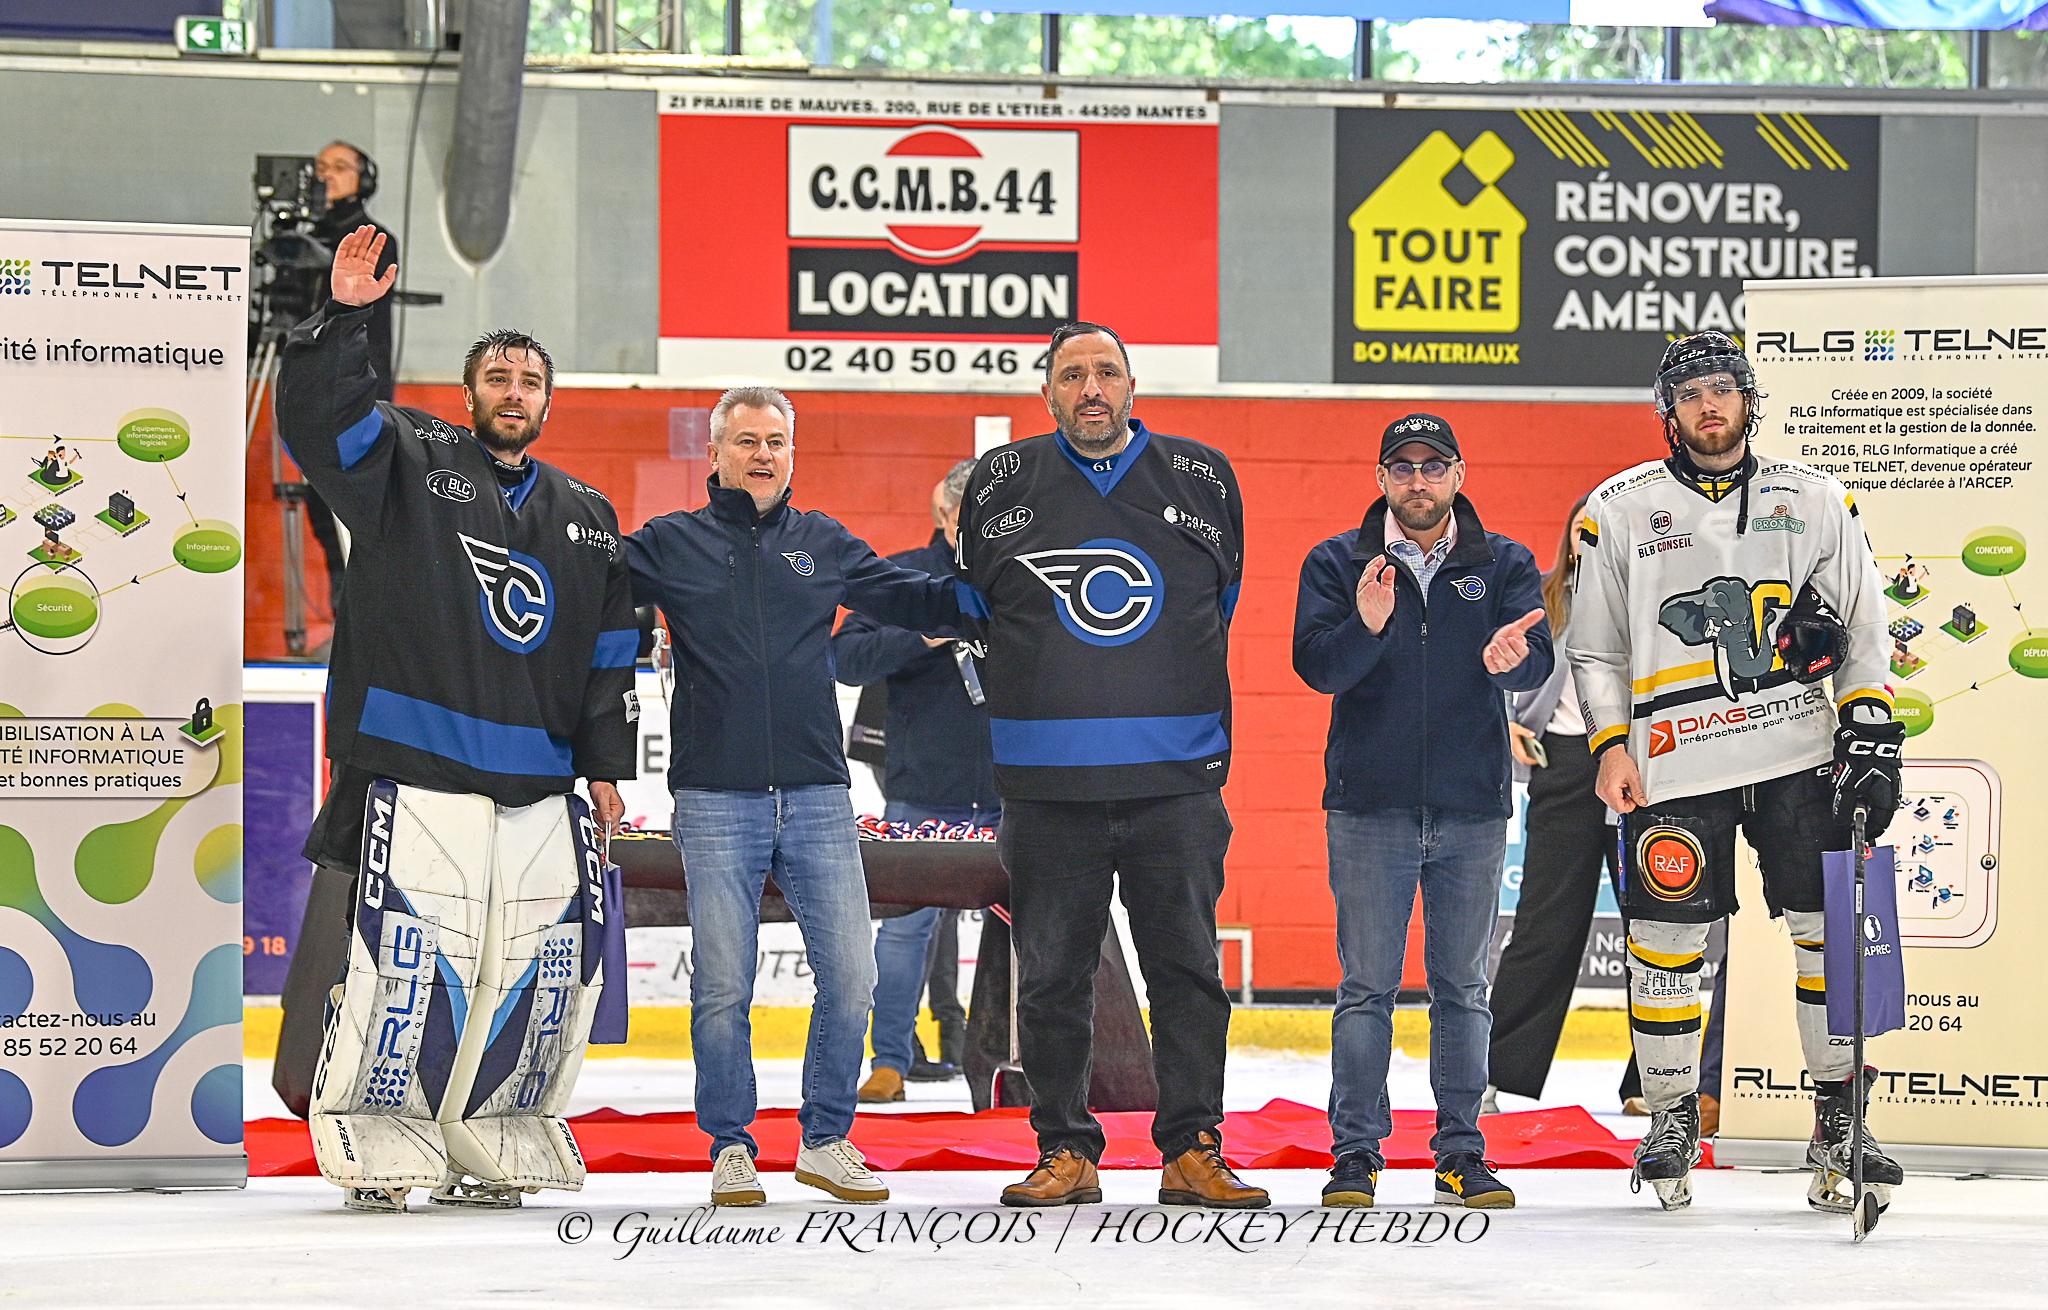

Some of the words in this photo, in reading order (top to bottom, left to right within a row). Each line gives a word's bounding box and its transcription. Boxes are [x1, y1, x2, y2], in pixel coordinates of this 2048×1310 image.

[693, 96, 763, 110] PRAIRIE
[770, 98, 793, 111] DE
[927, 102, 961, 115] RUE
[968, 103, 992, 116] DE
[997, 103, 1063, 117] L'ETIER
[1079, 104, 1130, 118] 44300
[1136, 105, 1207, 119] NANTES
[810, 164, 1057, 215] C.C.M.B.44
[1555, 175, 1800, 231] RÉNOVER,
[1373, 228, 1502, 265] TOUT
[1553, 235, 1874, 280] CONSTRUIRE,
[41, 260, 242, 291] TELNET
[41, 289, 140, 299] TÉLÉPHONIE
[169, 294, 242, 302] INTERNET
[797, 270, 1070, 319] LOCATION
[1374, 275, 1502, 313] FAIRE
[1756, 330, 1855, 354] RLG
[1904, 328, 2047, 351] TELNE
[46, 338, 224, 371] informatique
[786, 346, 832, 373] 02
[847, 347, 894, 373] 40
[910, 347, 956, 374] 50
[971, 349, 1018, 375] 46
[1354, 342, 1386, 363] BO
[1393, 342, 1520, 366] MATERIAUX
[1680, 349, 1706, 362] CCM
[1756, 355, 1855, 363] INFORMATIQUE
[1903, 353, 1987, 361] TÉLÉPHONIE
[1831, 388, 1869, 401] Créée
[1872, 390, 1888, 401] en
[1891, 388, 1928, 402] 2009,
[1932, 387, 1943, 400] la
[1946, 387, 1993, 400] société
[1789, 406, 1817, 418] RLG
[1820, 405, 1903, 421] Informatique
[1906, 407, 1926, 417] est
[1928, 404, 1999, 419] spécialisée
[2002, 404, 2033, 416] dans
[1784, 423, 1796, 435] le
[1799, 423, 1866, 435] traitement
[1869, 423, 1883, 434] et
[1885, 422, 1897, 434] la
[1900, 421, 1948, 437] gestion
[1951, 421, 1967, 433] de
[1970, 421, 1982, 433] la
[1985, 420, 2037, 433] donnée.
[1801, 445, 1818, 456] En
[1822, 444, 1860, 458] 2016,
[1863, 444, 1890, 456] RLG
[1893, 442, 1976, 459] Informatique
[1979, 446, 1988, 455] a
[1990, 441, 2018, 454] créé
[1093, 460, 1113, 472] 61
[1697, 467, 1744, 483] CCM
[1761, 463, 1789, 475] BTP
[1807, 463, 1850, 475] arque
[1853, 460, 1908, 474] TELNET,
[1911, 460, 1966, 472] devenue
[1969, 459, 2033, 475] opérateur
[448, 478, 471, 495] BLC
[1600, 481, 1626, 500] BTP
[1628, 466, 1667, 485] SAVOIE
[1840, 477, 1887, 492] onique
[1890, 477, 1945, 490] déclarée
[1948, 477, 1956, 489] à
[1959, 476, 2014, 489] l'ARCEP.
[1000, 510, 1026, 528] BLC
[185, 543, 231, 552] Infogérance
[1638, 545, 1656, 559] BLB
[1656, 537, 1693, 553] CONSEIL
[1975, 546, 2014, 555] CONCEVOIR
[36, 603, 73, 612] Sécurité
[120, 722, 137, 741] À
[140, 725, 164, 741] LA
[1680, 722, 1758, 746] Irréprochable
[1763, 717, 1785, 730] pour
[1788, 708, 1815, 721] votre
[29, 748, 185, 767] INFORMATIQUE
[0, 774, 16, 787] et
[21, 771, 88, 788] bonnes
[94, 772, 182, 791] pratiques
[365, 797, 397, 911] CCM
[578, 814, 605, 925] CCM
[1654, 855, 1690, 874] RAF
[260, 936, 287, 957] 18
[377, 925, 422, 1060] RLG
[1652, 985, 1694, 996] GESTION
[1907, 994, 1951, 1007] nous
[1957, 995, 1979, 1007] au
[131, 1012, 156, 1027] au
[1909, 1014, 1933, 1031] 20
[1939, 1015, 1963, 1032] 64
[4, 1038, 32, 1056] 85
[39, 1037, 67, 1056] 52
[74, 1037, 103, 1055] 20
[109, 1036, 138, 1055] 64
[1880, 1071, 2048, 1098] TELNET
[1878, 1095, 1960, 1106] TÉLÉPHONIE
